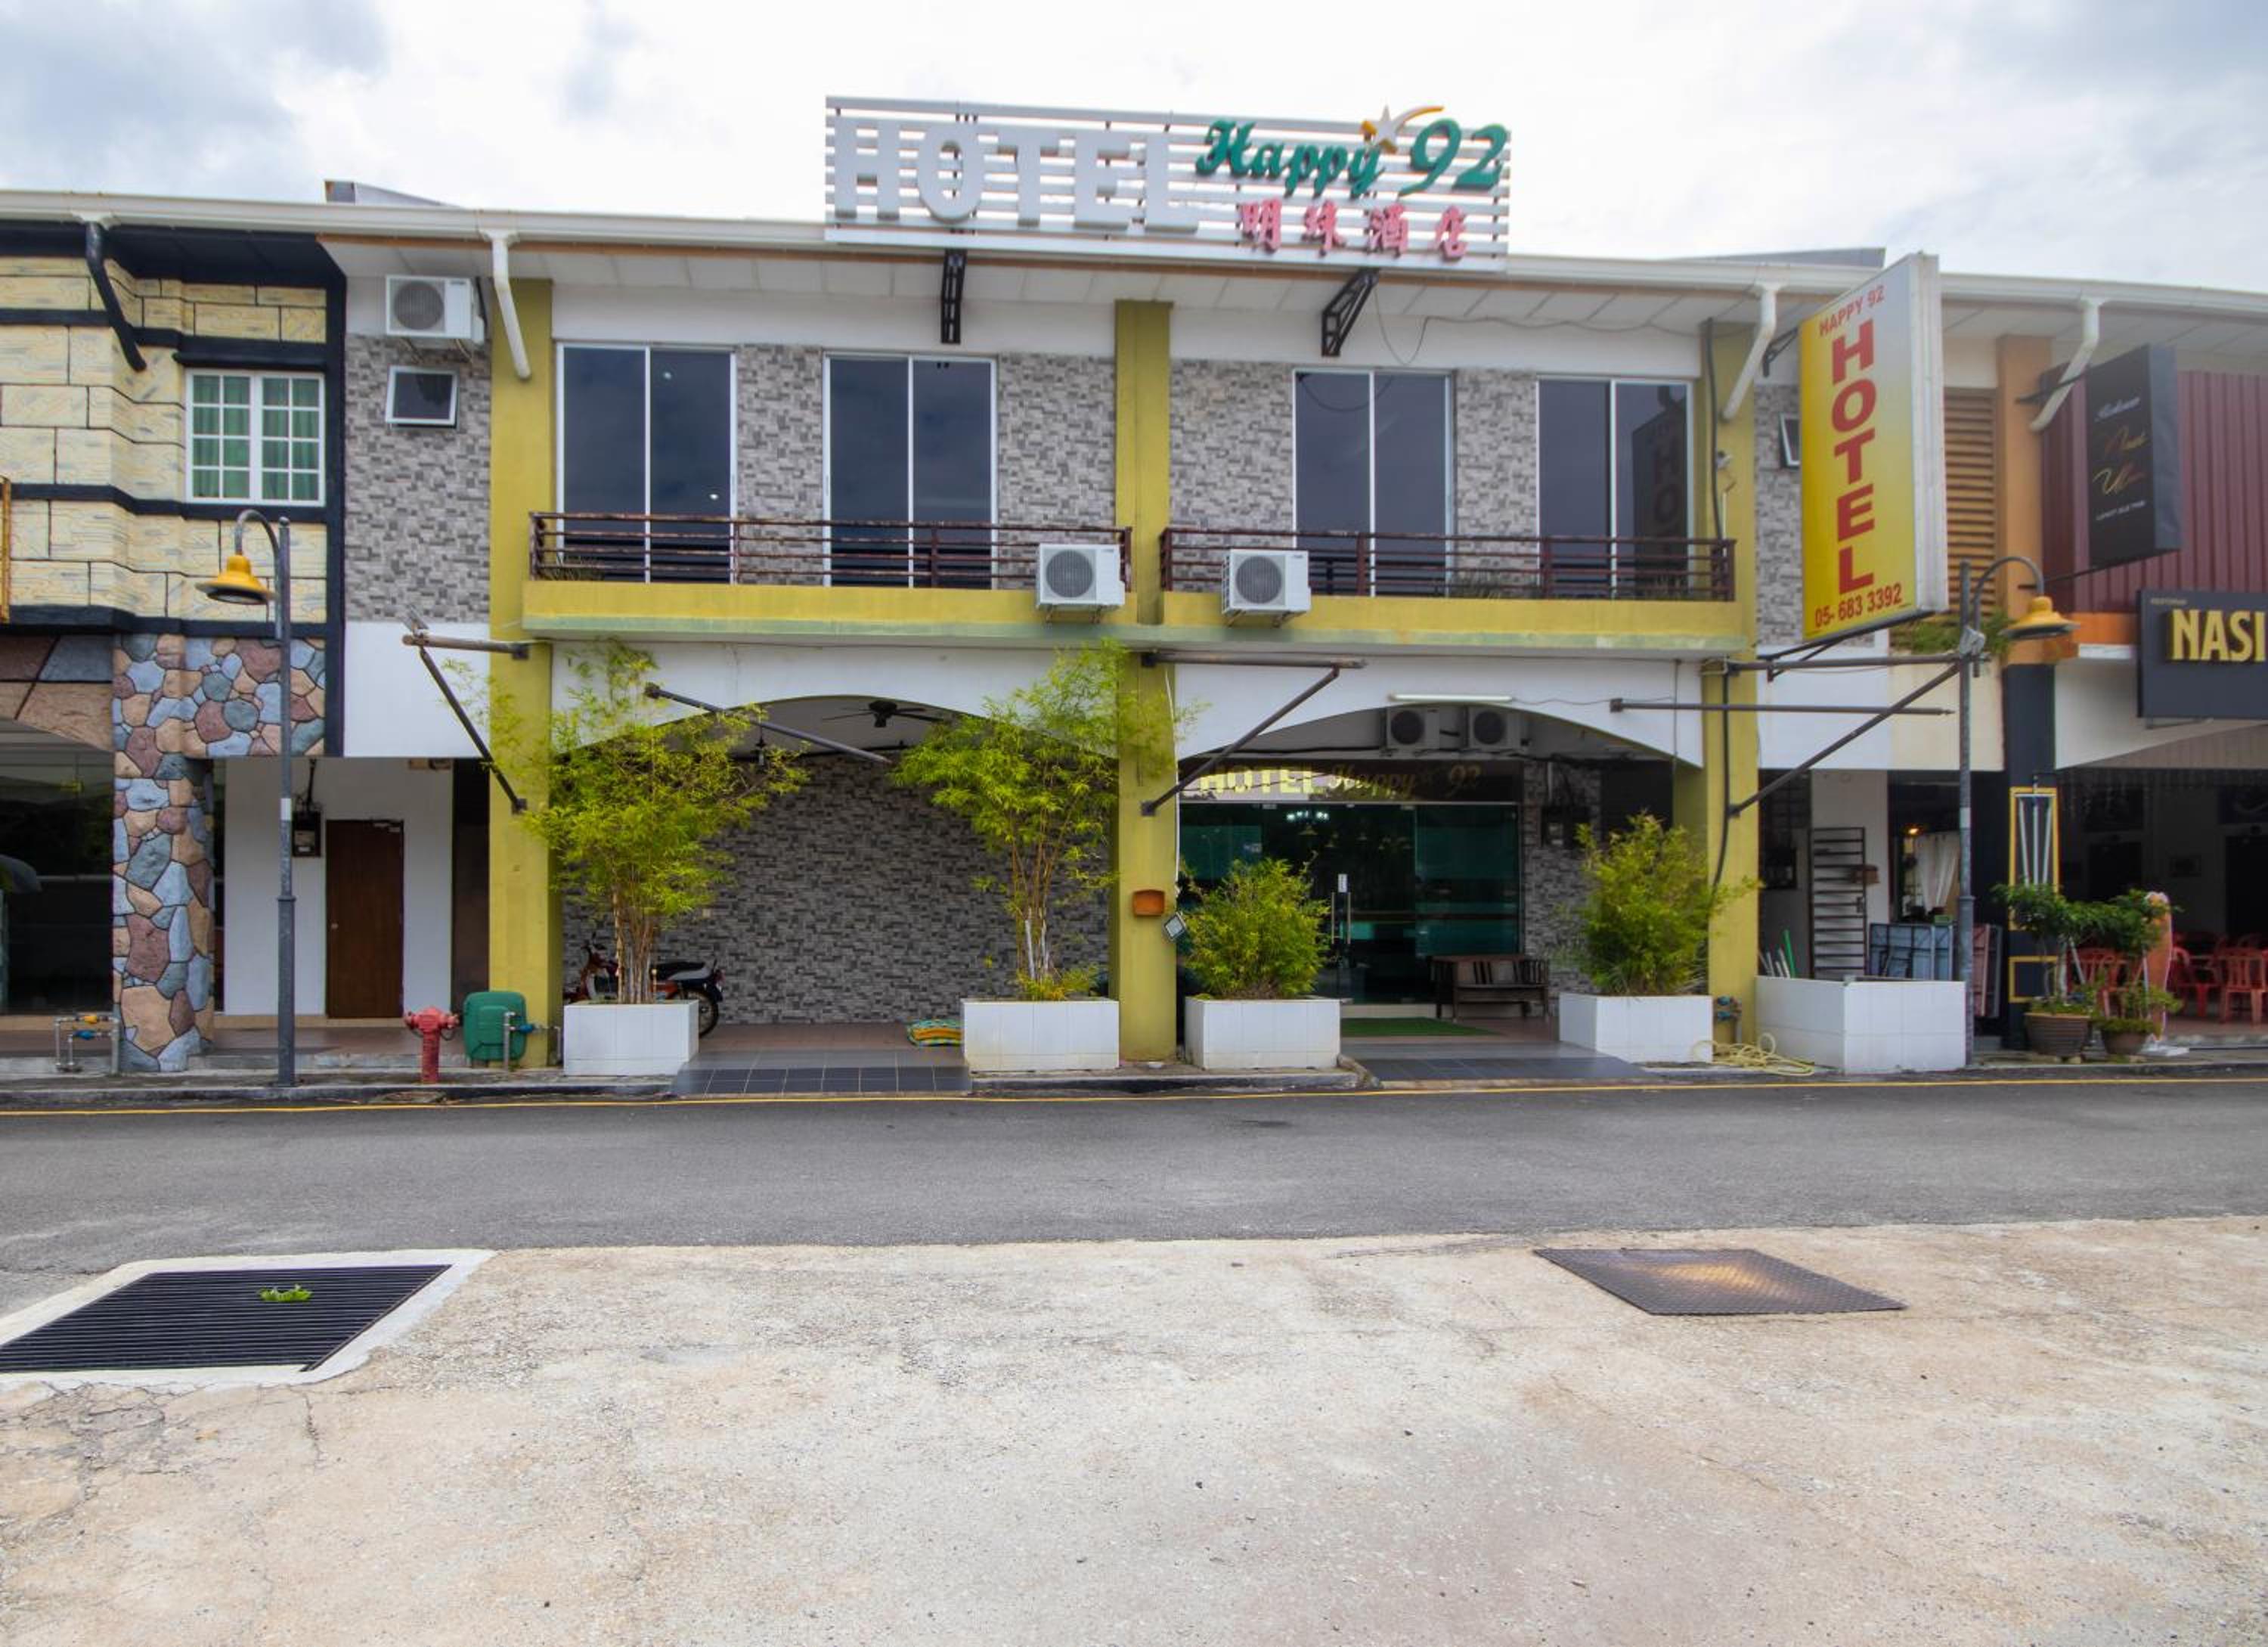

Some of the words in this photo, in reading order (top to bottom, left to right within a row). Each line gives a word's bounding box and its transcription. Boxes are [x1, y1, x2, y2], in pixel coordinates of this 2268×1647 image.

[834, 116, 1199, 233] HOTEL
[1195, 116, 1385, 200] Happy
[1398, 116, 1508, 197] 92
[1238, 197, 1467, 262] 明珠酒店
[1819, 296, 1864, 337] HAPPY
[1867, 284, 1885, 307] 92
[1831, 318, 1876, 595] HOTEL
[1839, 594, 1863, 621] 683
[1867, 582, 1902, 612] 3392
[2170, 608, 2266, 663] NASI
[1199, 765, 1326, 795] HOTEL
